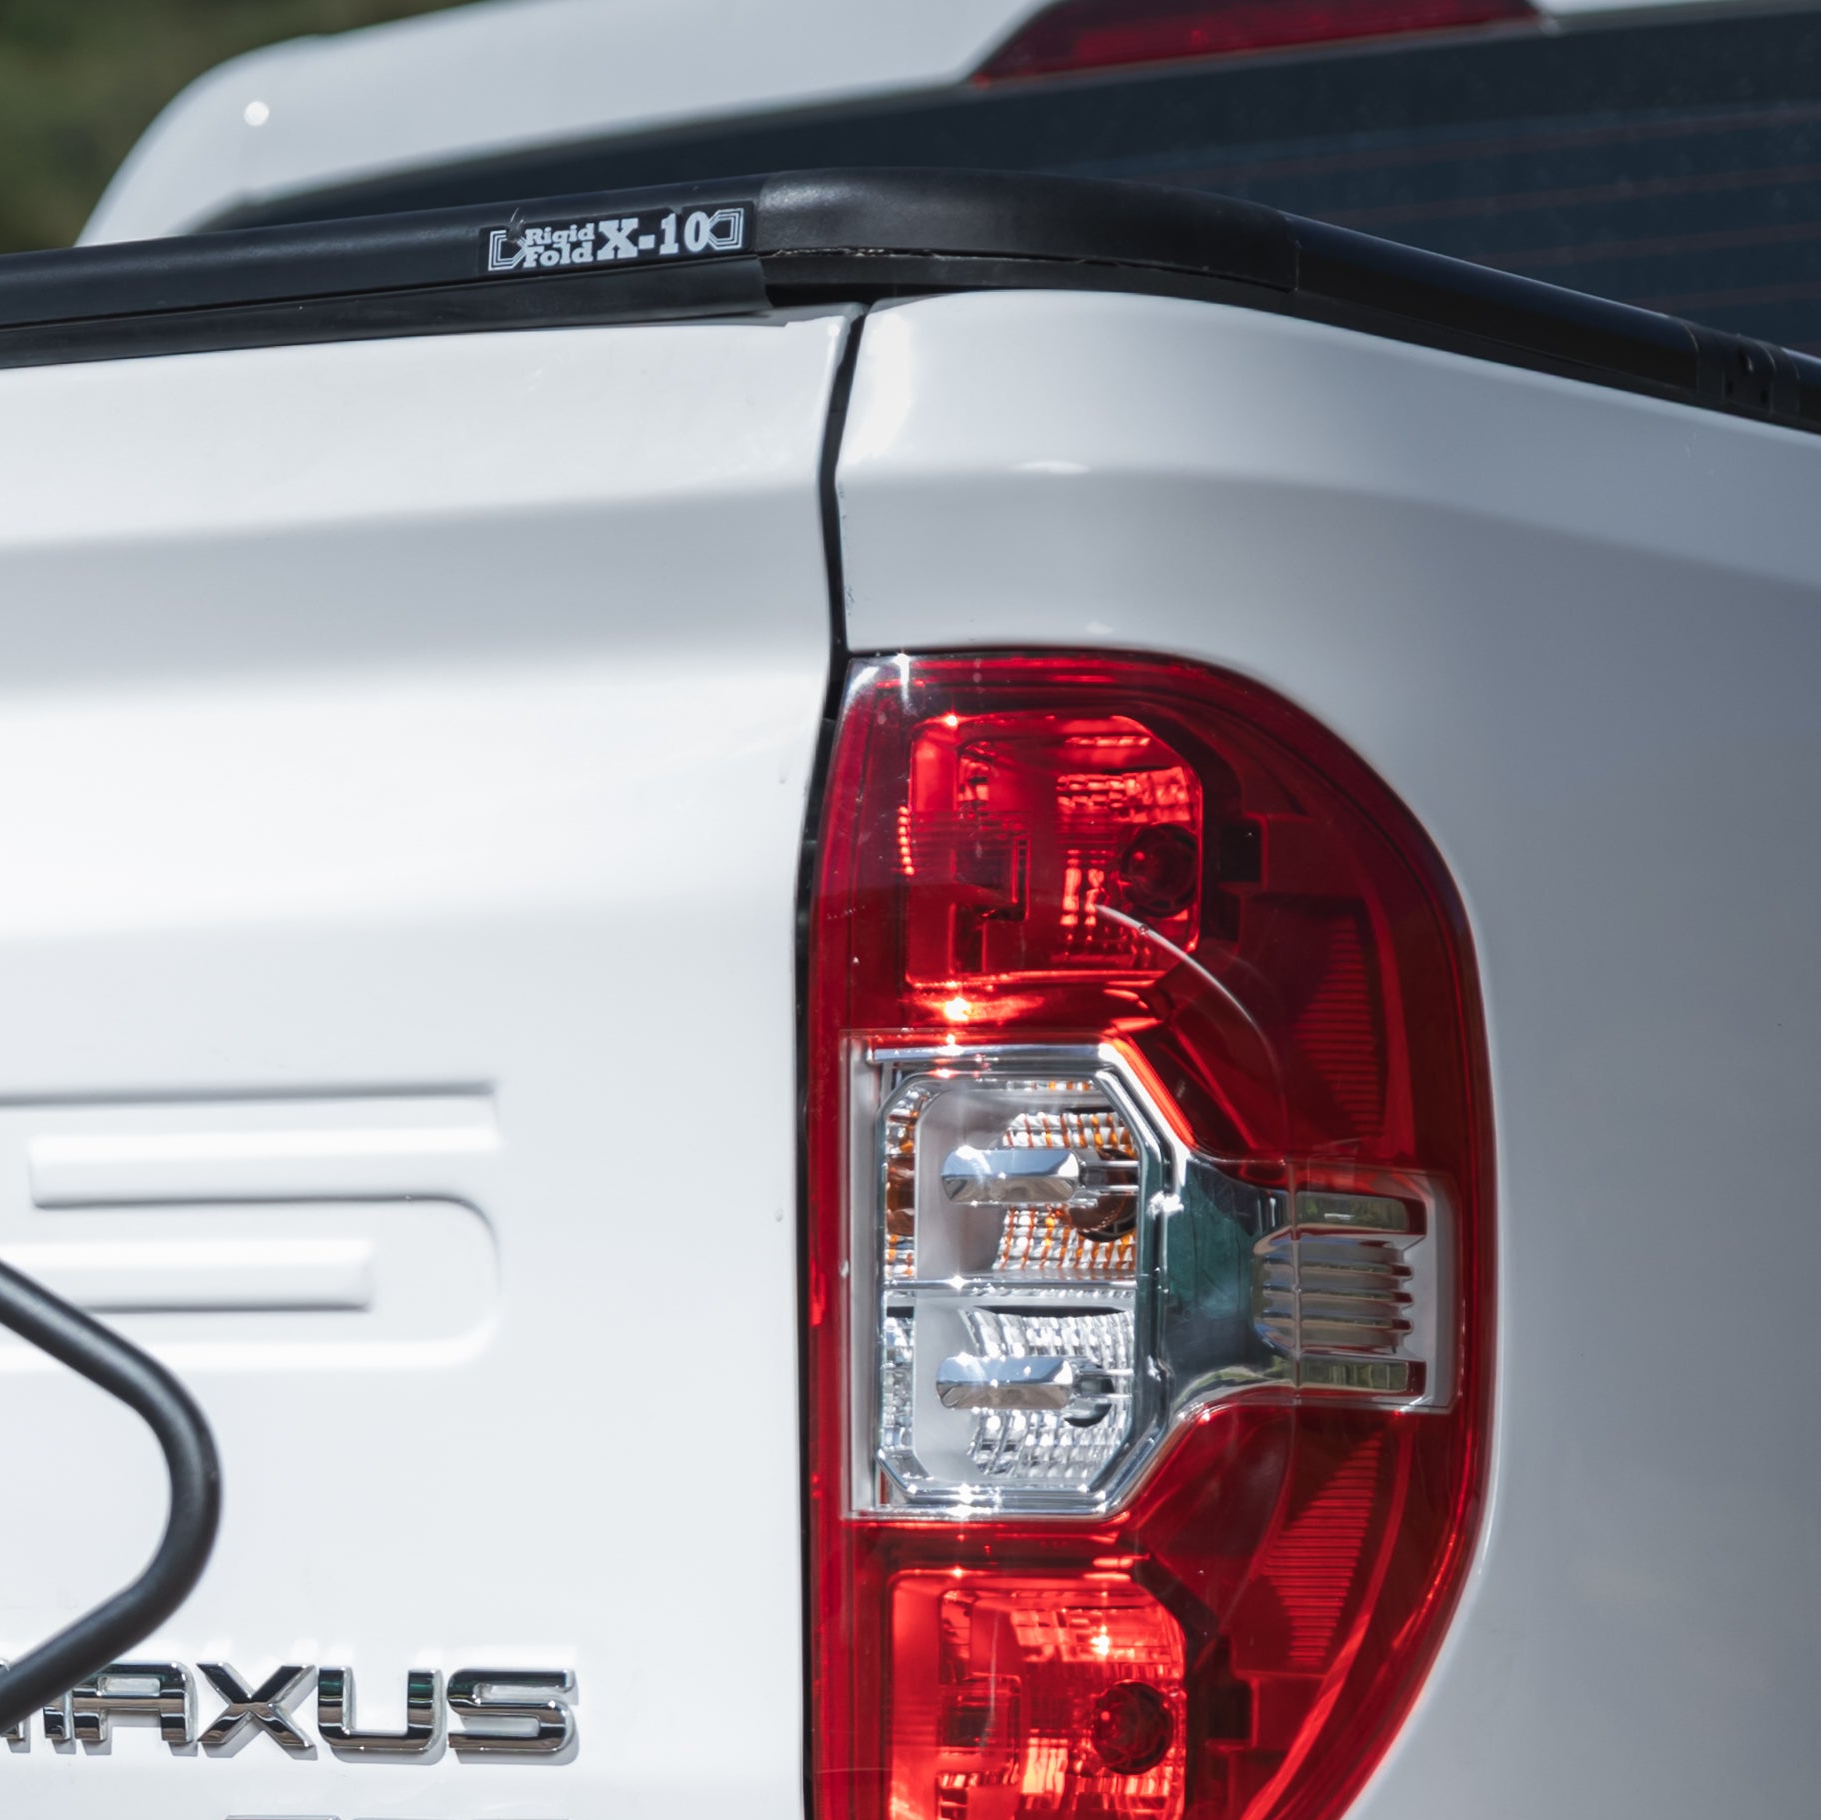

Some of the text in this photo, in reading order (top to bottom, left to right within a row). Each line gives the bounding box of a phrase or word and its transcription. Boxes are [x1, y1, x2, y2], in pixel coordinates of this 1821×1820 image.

[524, 222, 595, 249] Rigid
[597, 211, 711, 261] X-10
[522, 241, 594, 269] Fold
